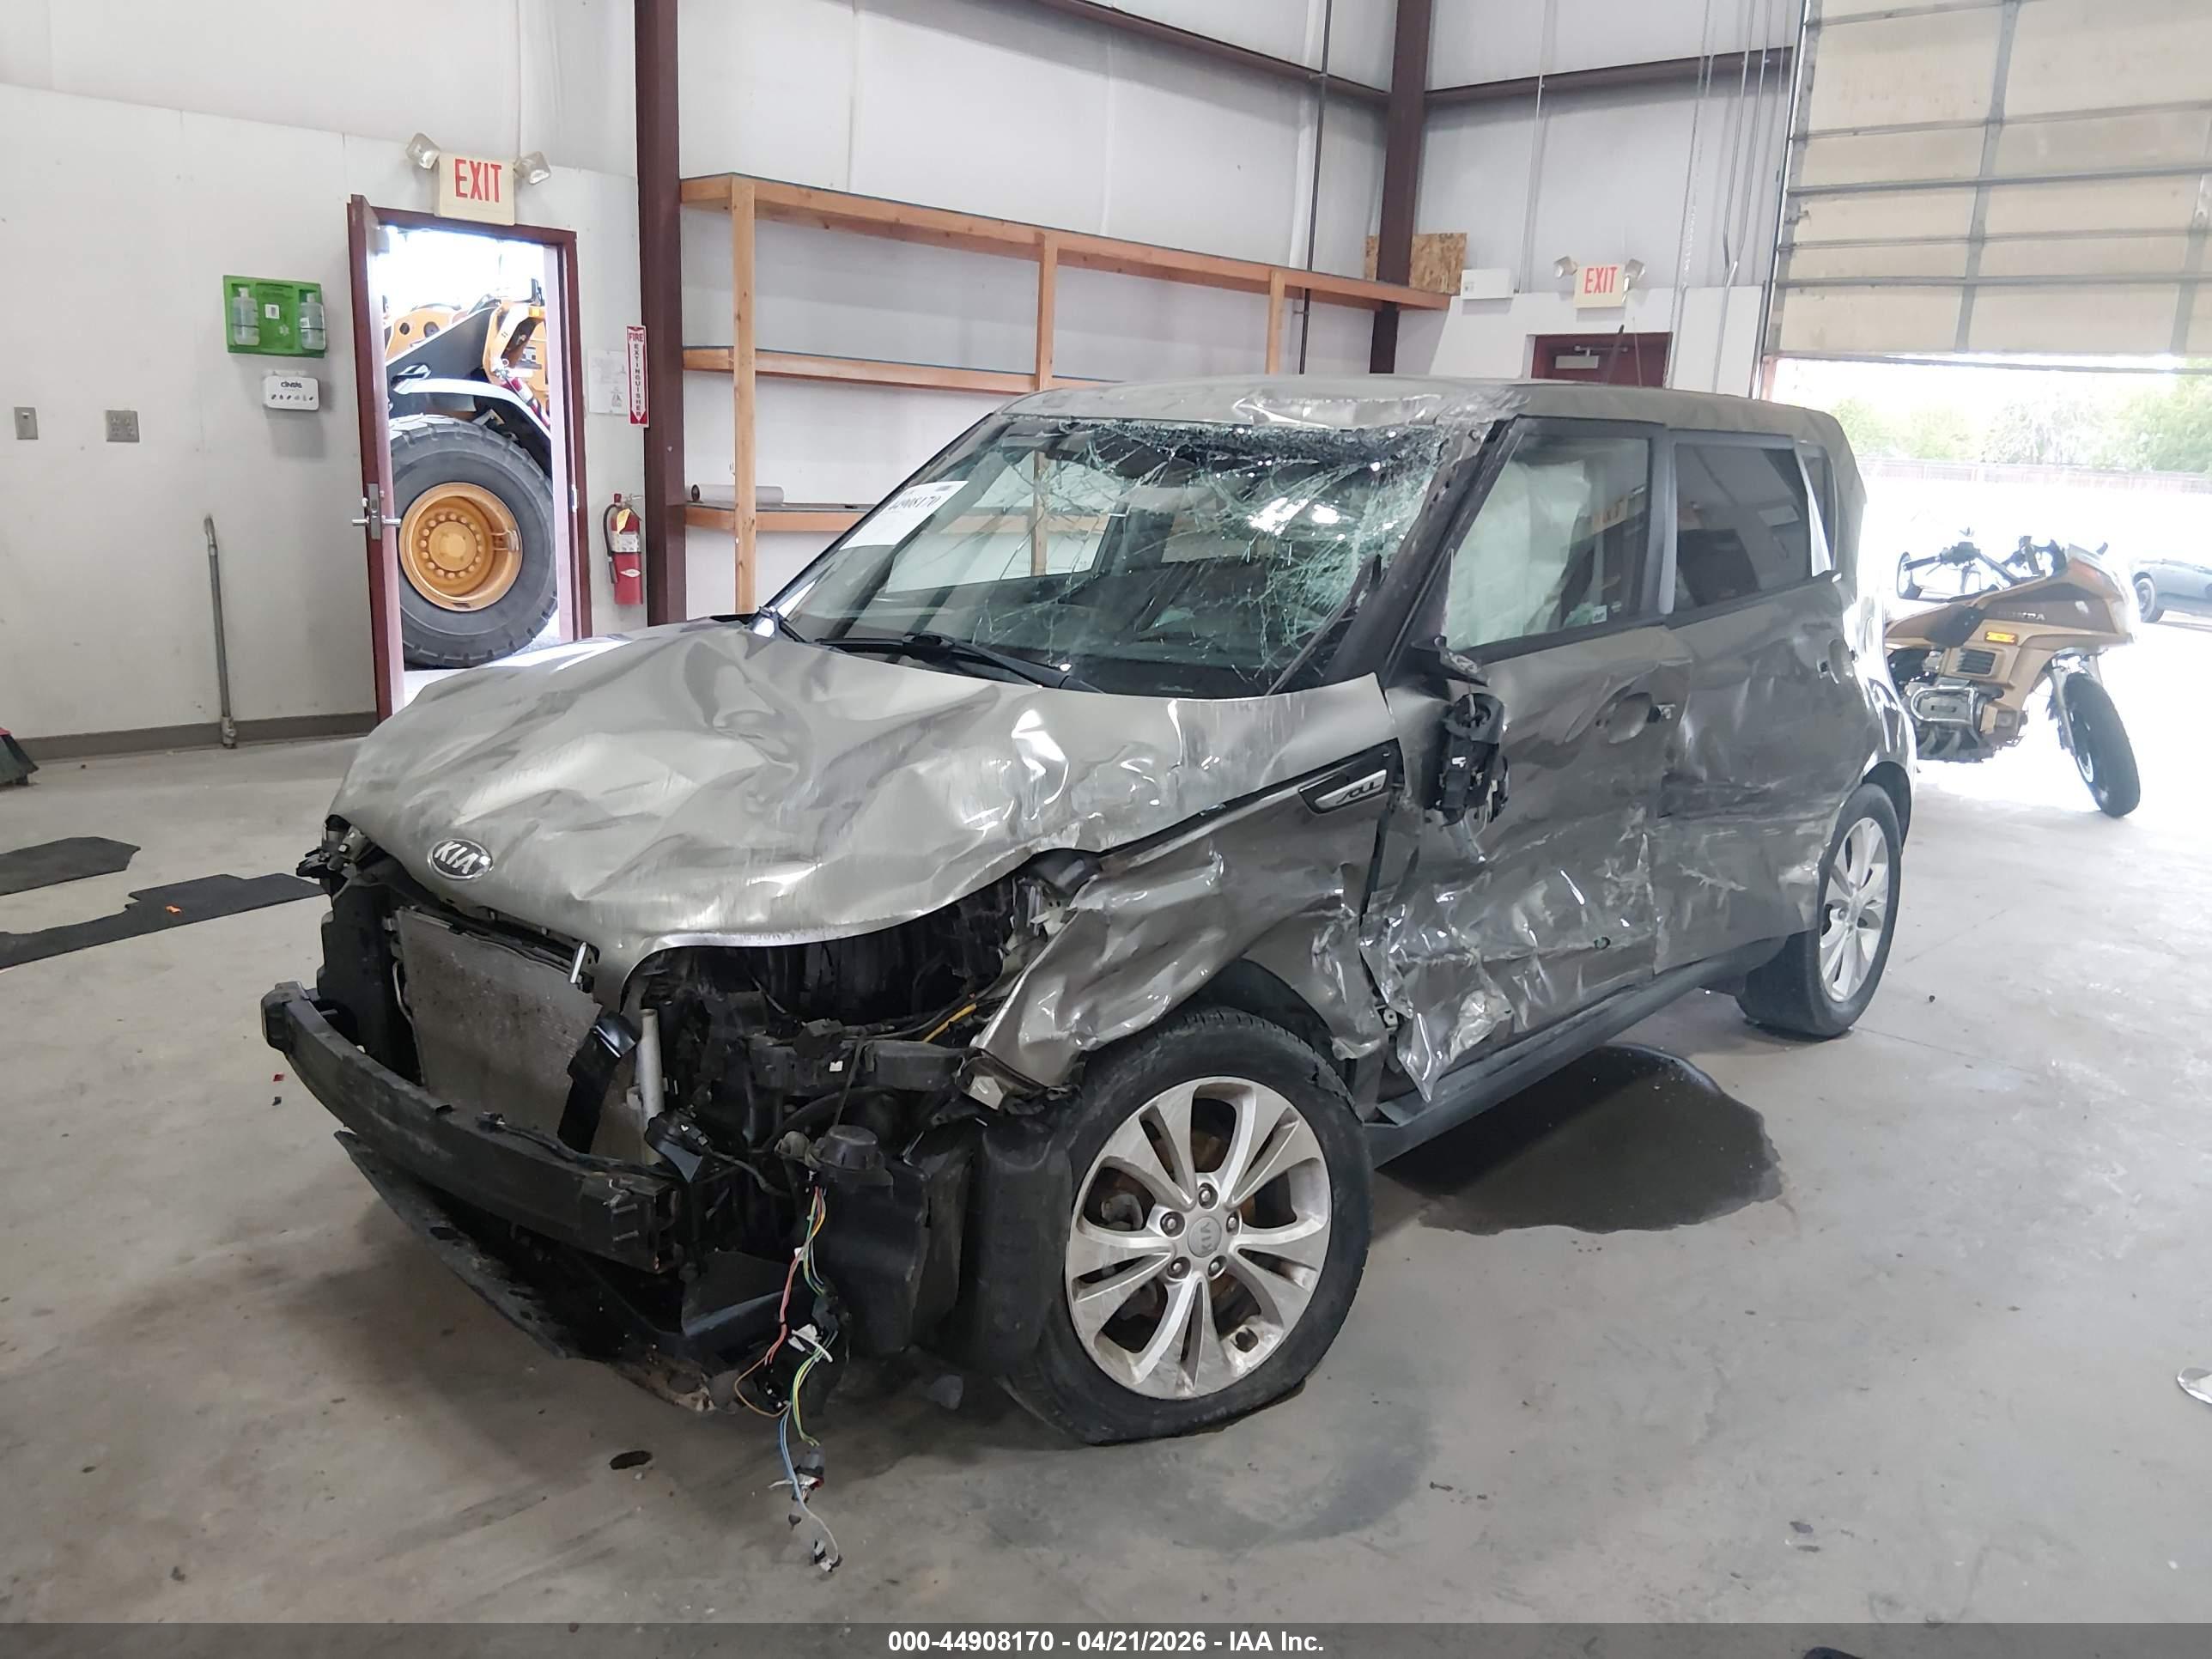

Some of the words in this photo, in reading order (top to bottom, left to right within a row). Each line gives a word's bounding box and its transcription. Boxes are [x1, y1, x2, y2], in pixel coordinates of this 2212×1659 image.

[454, 158, 502, 203] EXIT
[1584, 266, 1618, 294] EXIT
[629, 332, 644, 343] FIRE
[633, 343, 642, 417] EXTINGUISHER
[434, 841, 479, 874] KIA
[1200, 1221, 1212, 1256] KIA
